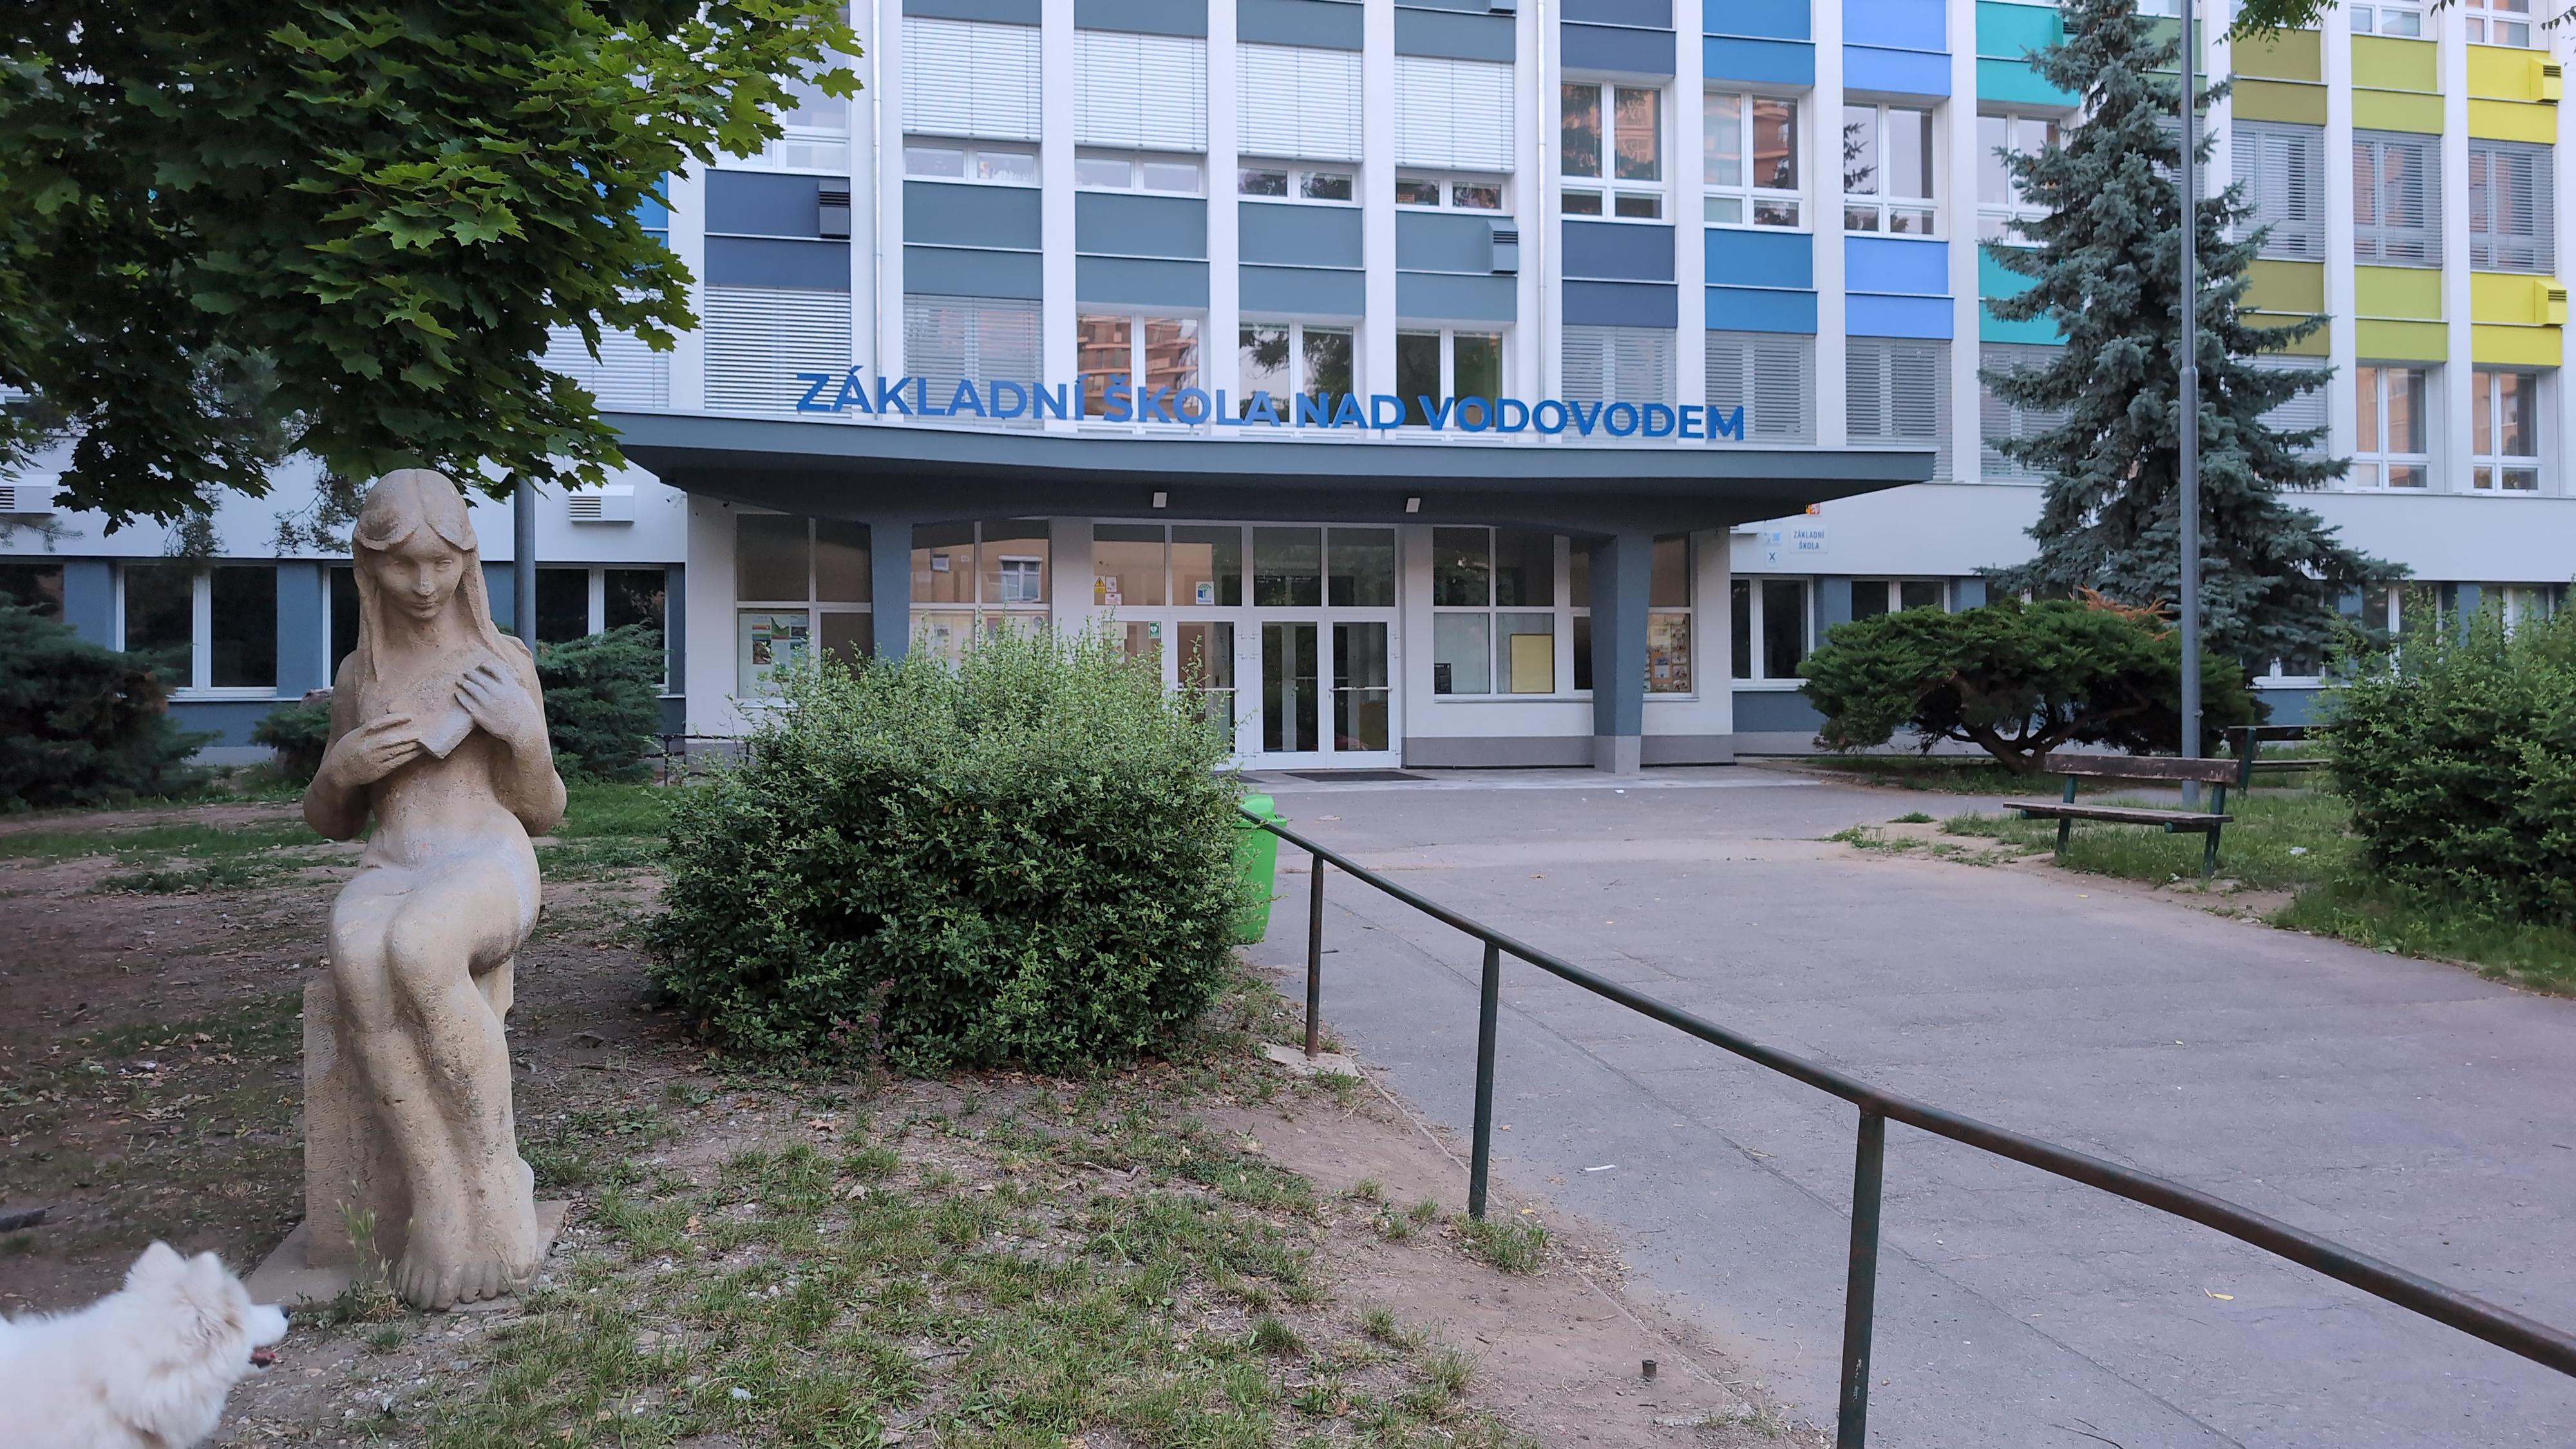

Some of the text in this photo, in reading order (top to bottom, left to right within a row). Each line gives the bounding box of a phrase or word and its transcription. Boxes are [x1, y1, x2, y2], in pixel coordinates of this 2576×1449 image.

[795, 365, 1745, 440] ZÁKLADNÍ ŠKOLA NAD VODOVODEM
[1793, 528, 1824, 538] ZÁKLADNÍ
[1799, 540, 1819, 550] ŠKOLA
